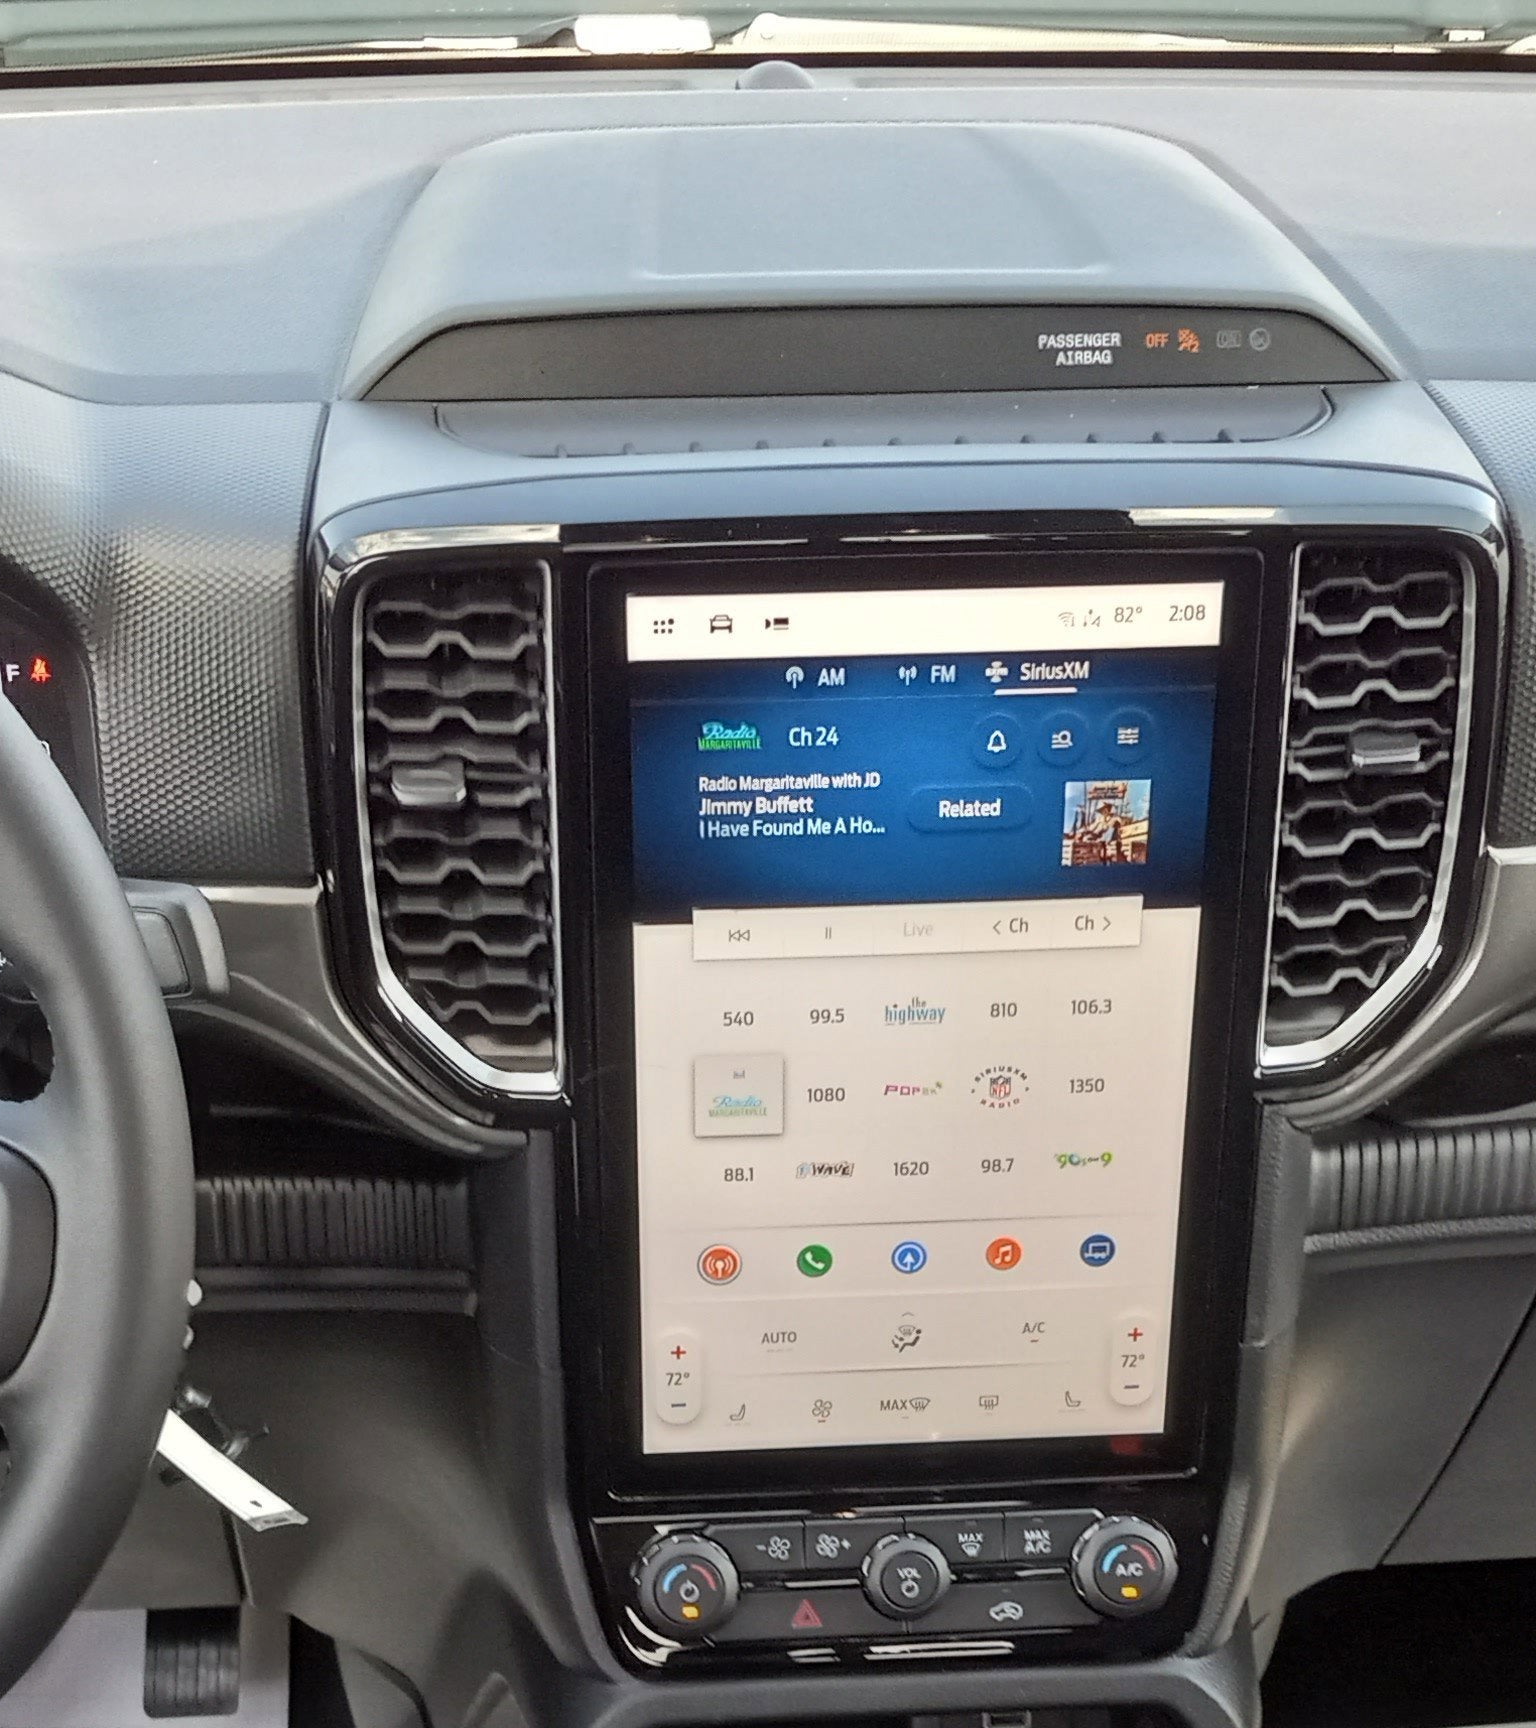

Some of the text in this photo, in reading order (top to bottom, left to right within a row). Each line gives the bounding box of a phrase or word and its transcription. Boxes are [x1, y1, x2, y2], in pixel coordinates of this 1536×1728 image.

[1038, 332, 1121, 349] PASSENGER
[1145, 333, 1169, 348] OFF
[1055, 350, 1113, 366] AIRBAG
[1113, 606, 1144, 624] 82°
[1168, 604, 1207, 622] 2:08
[6, 663, 20, 682] F
[816, 667, 846, 686] AM
[930, 665, 957, 684] FM
[1019, 660, 1091, 682] SiriusXM
[701, 720, 757, 739] Radio
[788, 726, 840, 747] Ch 24
[698, 771, 881, 793] Radio Margaritaville with JD
[698, 796, 814, 817] Jimmy Buffett
[938, 798, 1002, 818] Related
[699, 816, 886, 839] I Have Found Me A Ho...
[903, 921, 934, 937] Live
[1009, 917, 1029, 934] Ch
[1074, 915, 1094, 931] Ch
[884, 1003, 946, 1024] highway
[990, 1002, 1018, 1018] 810
[1070, 999, 1112, 1015] 106.3
[723, 1010, 754, 1027] 540
[809, 1008, 845, 1024] 99.5
[1069, 1078, 1105, 1094] 1350
[807, 1087, 846, 1103] 1080
[893, 1161, 930, 1177] 1620
[981, 1158, 1015, 1173] 98.7
[723, 1166, 755, 1182] 88.1
[1022, 1322, 1046, 1334] A/C
[760, 1331, 798, 1344] AUTO
[1121, 1354, 1145, 1368] 72°
[665, 1372, 690, 1386] 72°
[879, 1399, 908, 1411] MAX
[958, 1532, 984, 1544] MAX
[1023, 1529, 1050, 1541] MAX
[1024, 1541, 1052, 1555] A/C
[896, 1567, 921, 1579] VOL
[1115, 1563, 1144, 1577] A/C
